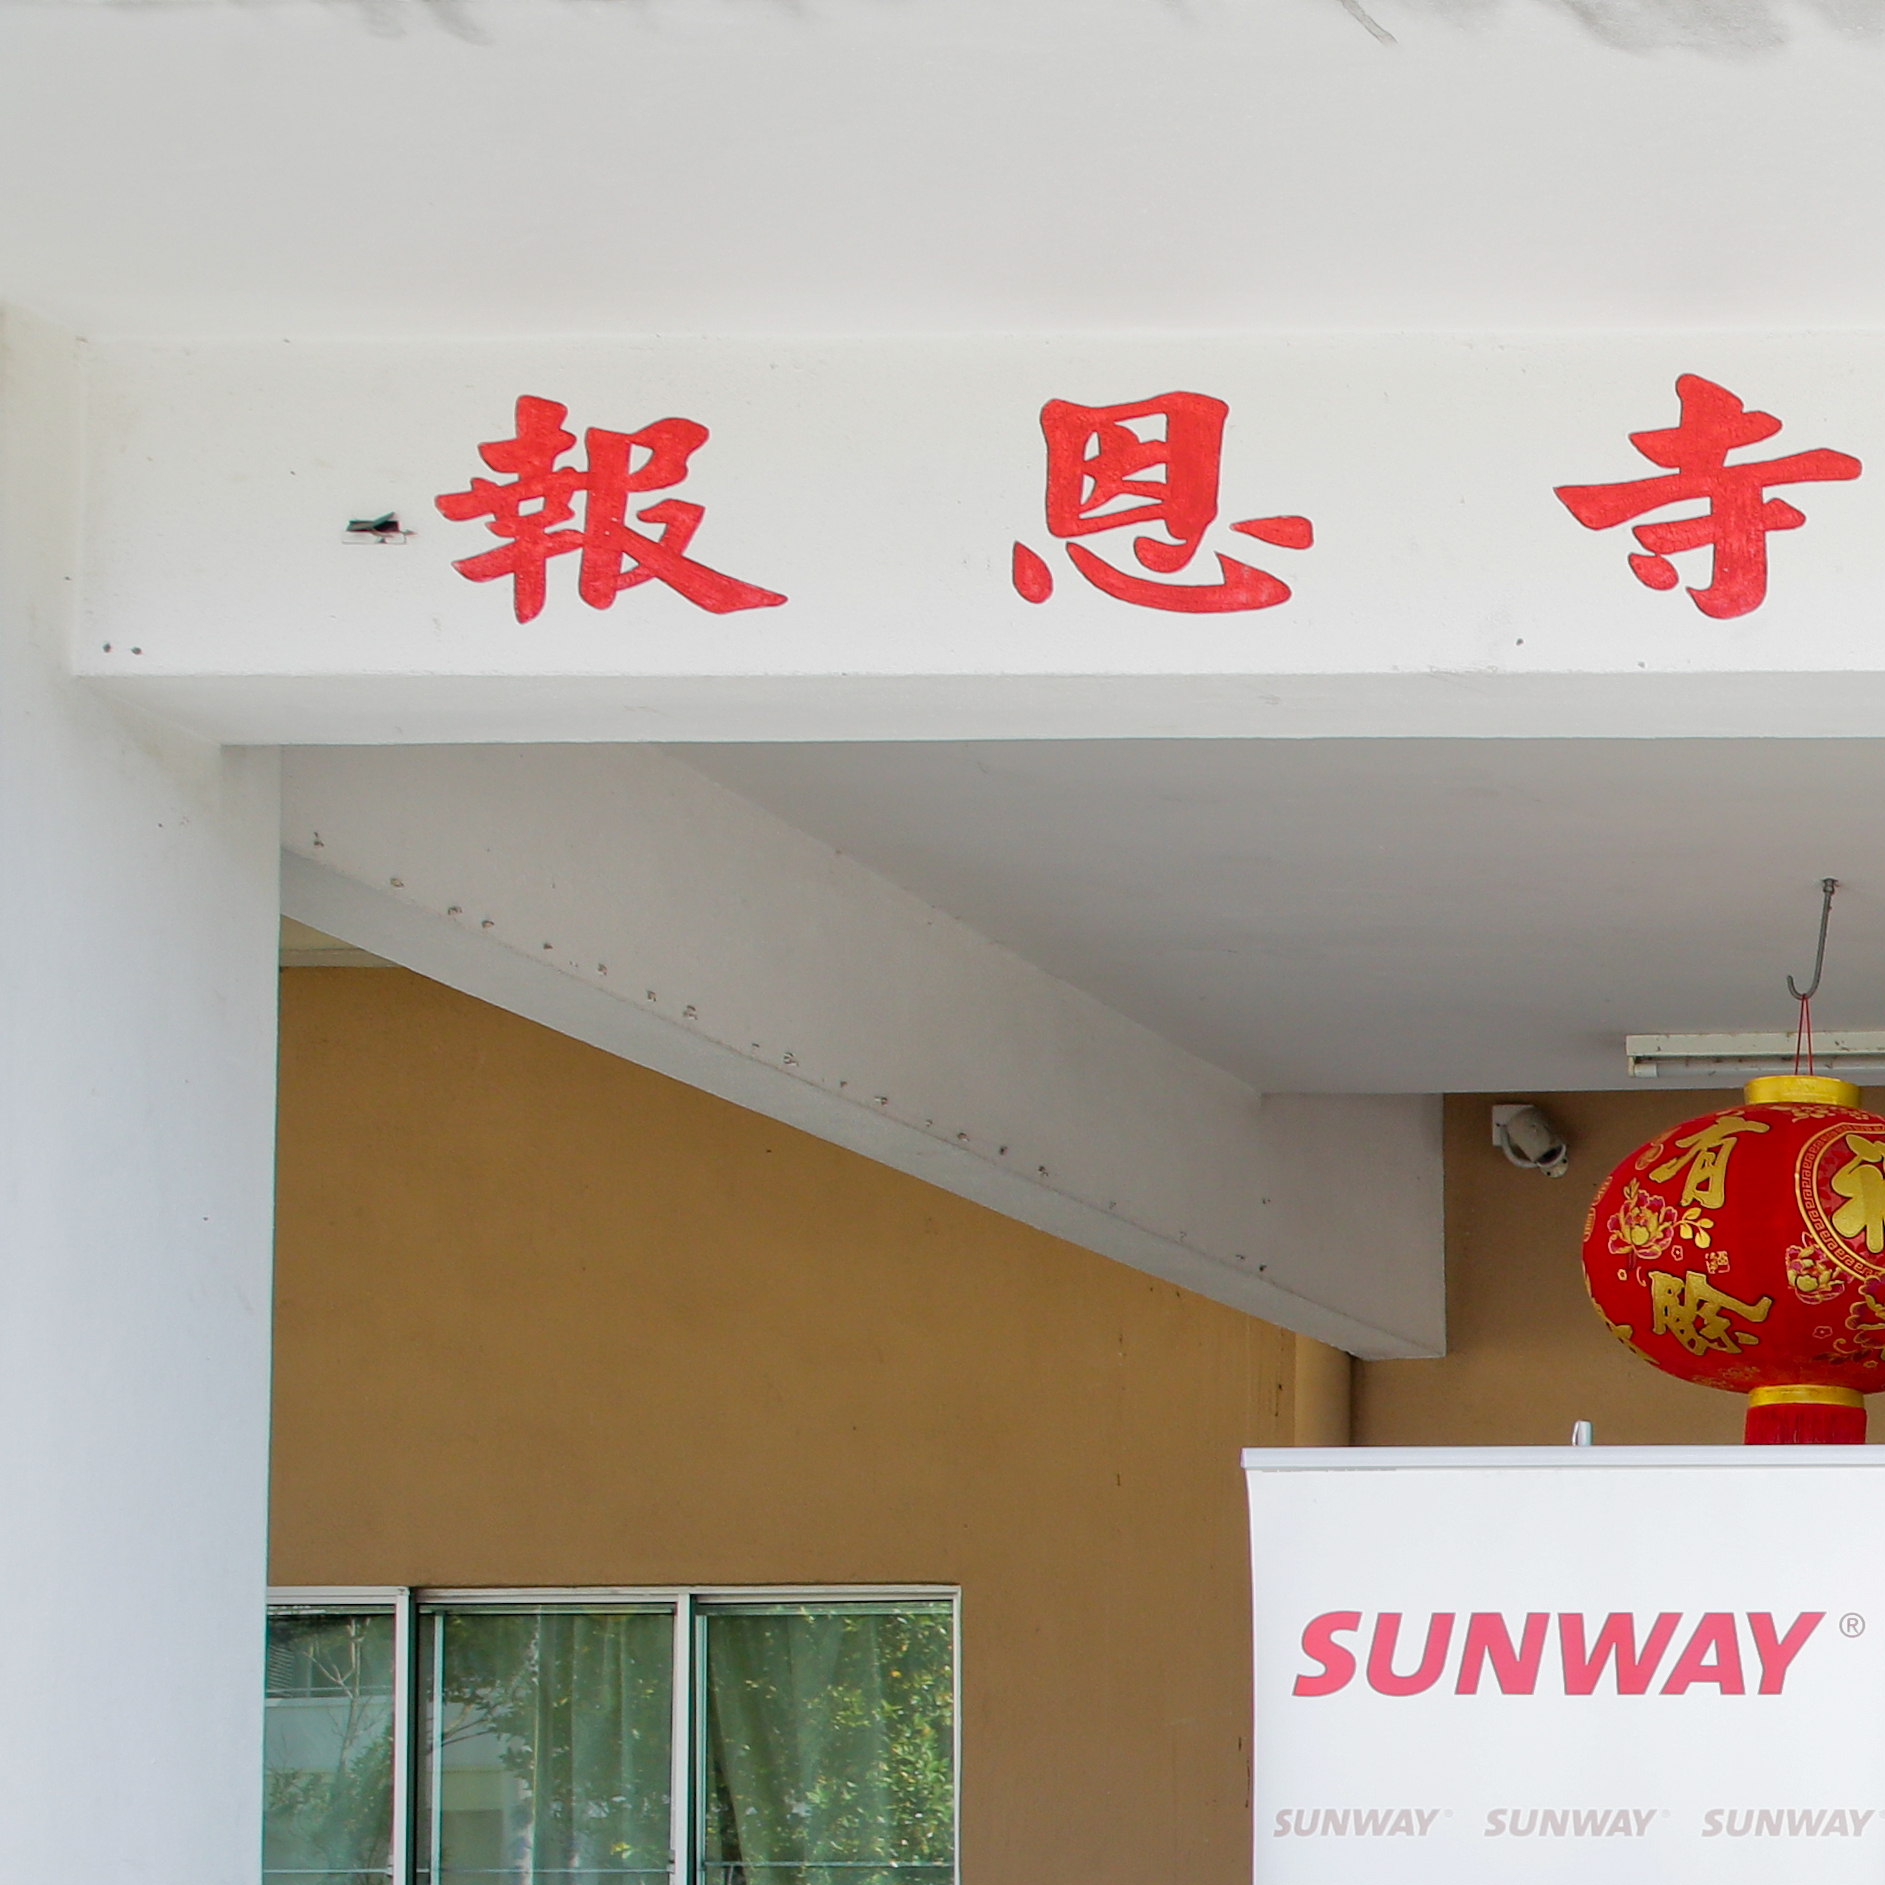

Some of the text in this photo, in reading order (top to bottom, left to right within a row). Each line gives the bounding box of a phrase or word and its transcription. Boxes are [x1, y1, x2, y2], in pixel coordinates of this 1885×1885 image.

[1292, 1610, 1826, 1697] SUNWAY
[1273, 1809, 1875, 1837] SUNWAY SUNWAY SUNWAY
